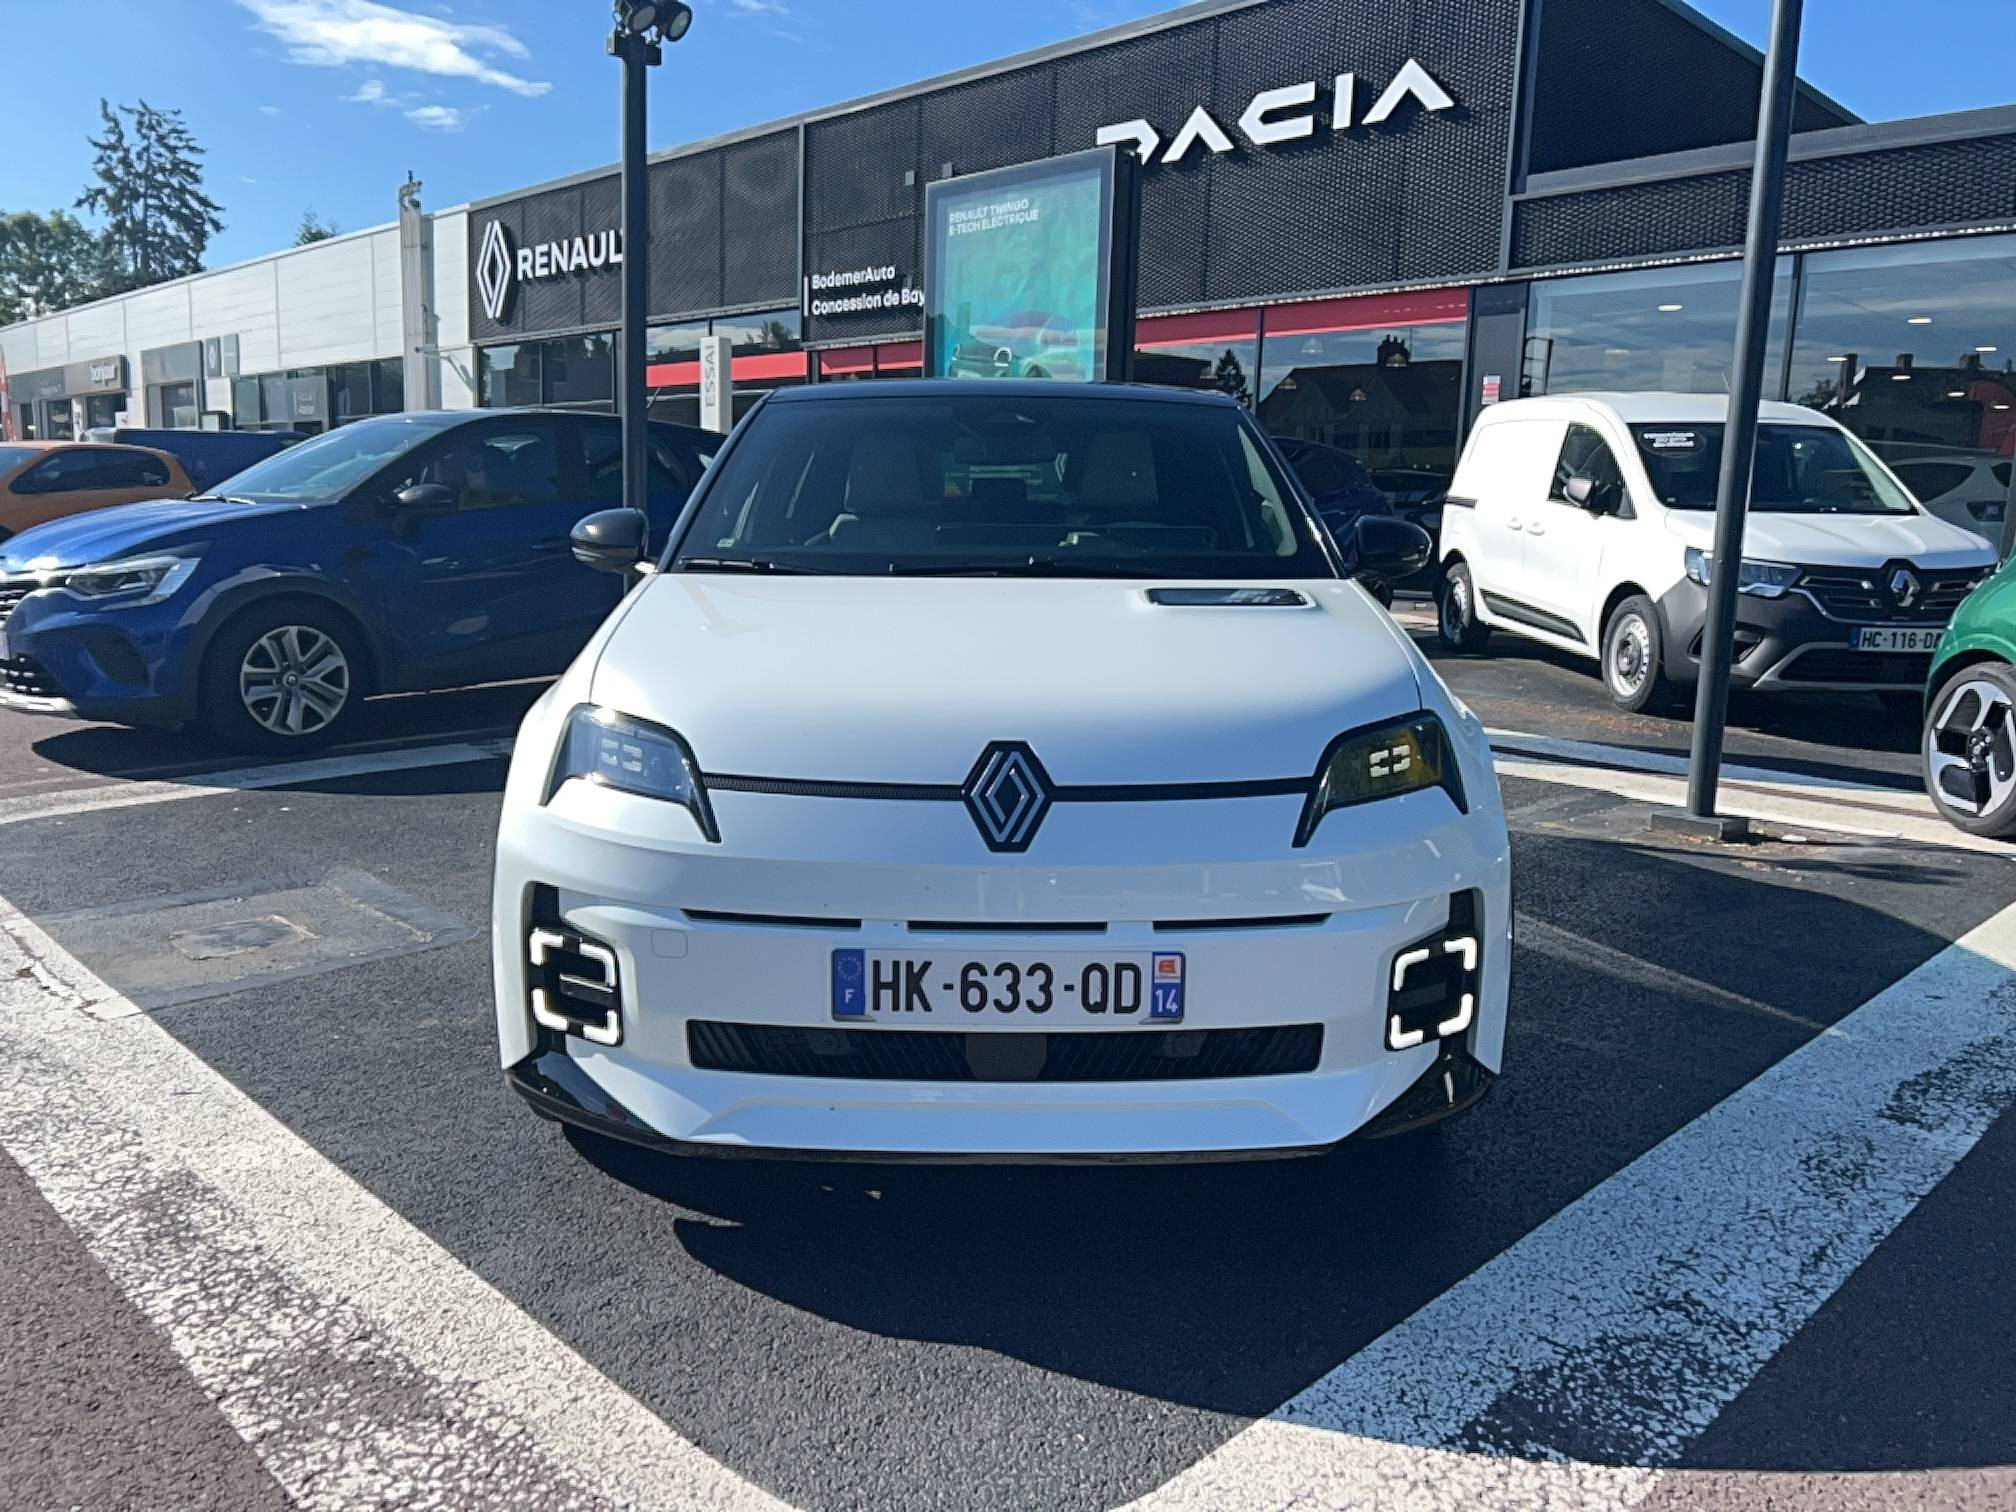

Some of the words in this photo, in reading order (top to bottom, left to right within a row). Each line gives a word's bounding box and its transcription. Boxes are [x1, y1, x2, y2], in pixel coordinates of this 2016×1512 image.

[516, 229, 624, 281] RENAUL
[811, 265, 895, 289] BodemerAuto
[811, 292, 882, 316] Concession
[883, 289, 900, 308] de
[704, 345, 716, 408] ESSAI
[844, 988, 855, 1004] F
[872, 959, 1142, 1014] HK-633-QD
[1154, 988, 1179, 1014] 14
